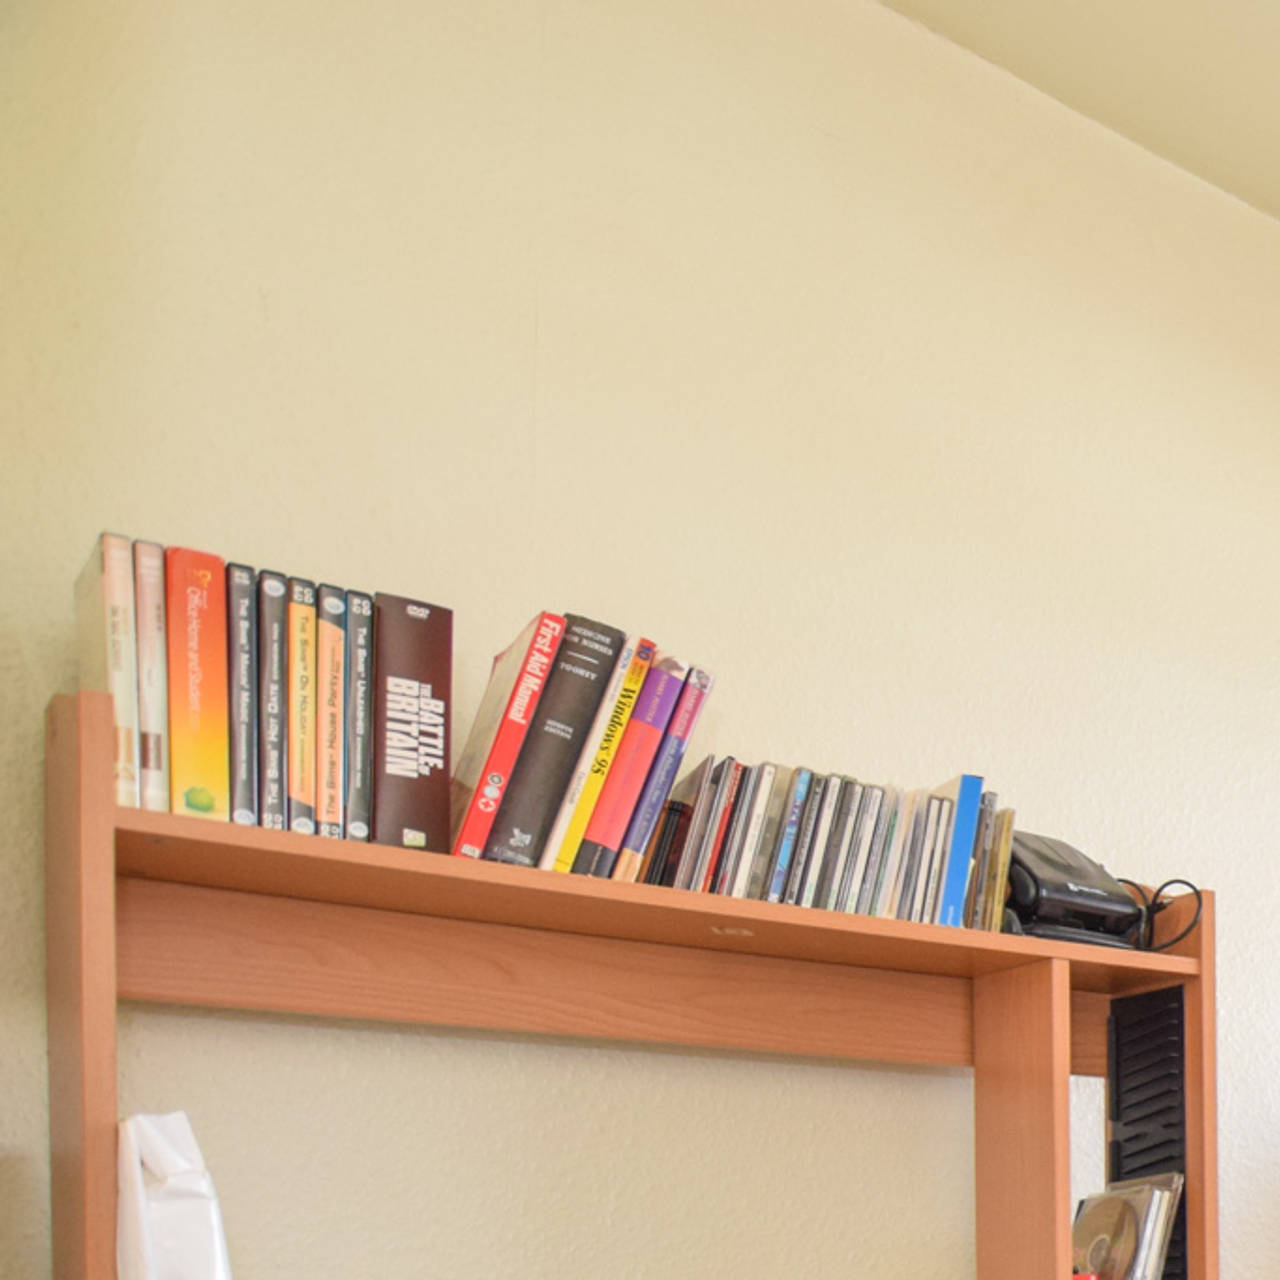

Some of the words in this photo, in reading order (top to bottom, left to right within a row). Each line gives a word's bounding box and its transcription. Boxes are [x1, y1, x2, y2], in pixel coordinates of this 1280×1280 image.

[534, 618, 561, 653] First
[525, 650, 549, 677] Aid
[508, 672, 542, 725] Manual
[600, 687, 637, 752] Windows
[386, 675, 419, 778] BRITAIN
[419, 697, 445, 769] BATTLE
[591, 758, 608, 776] 95
